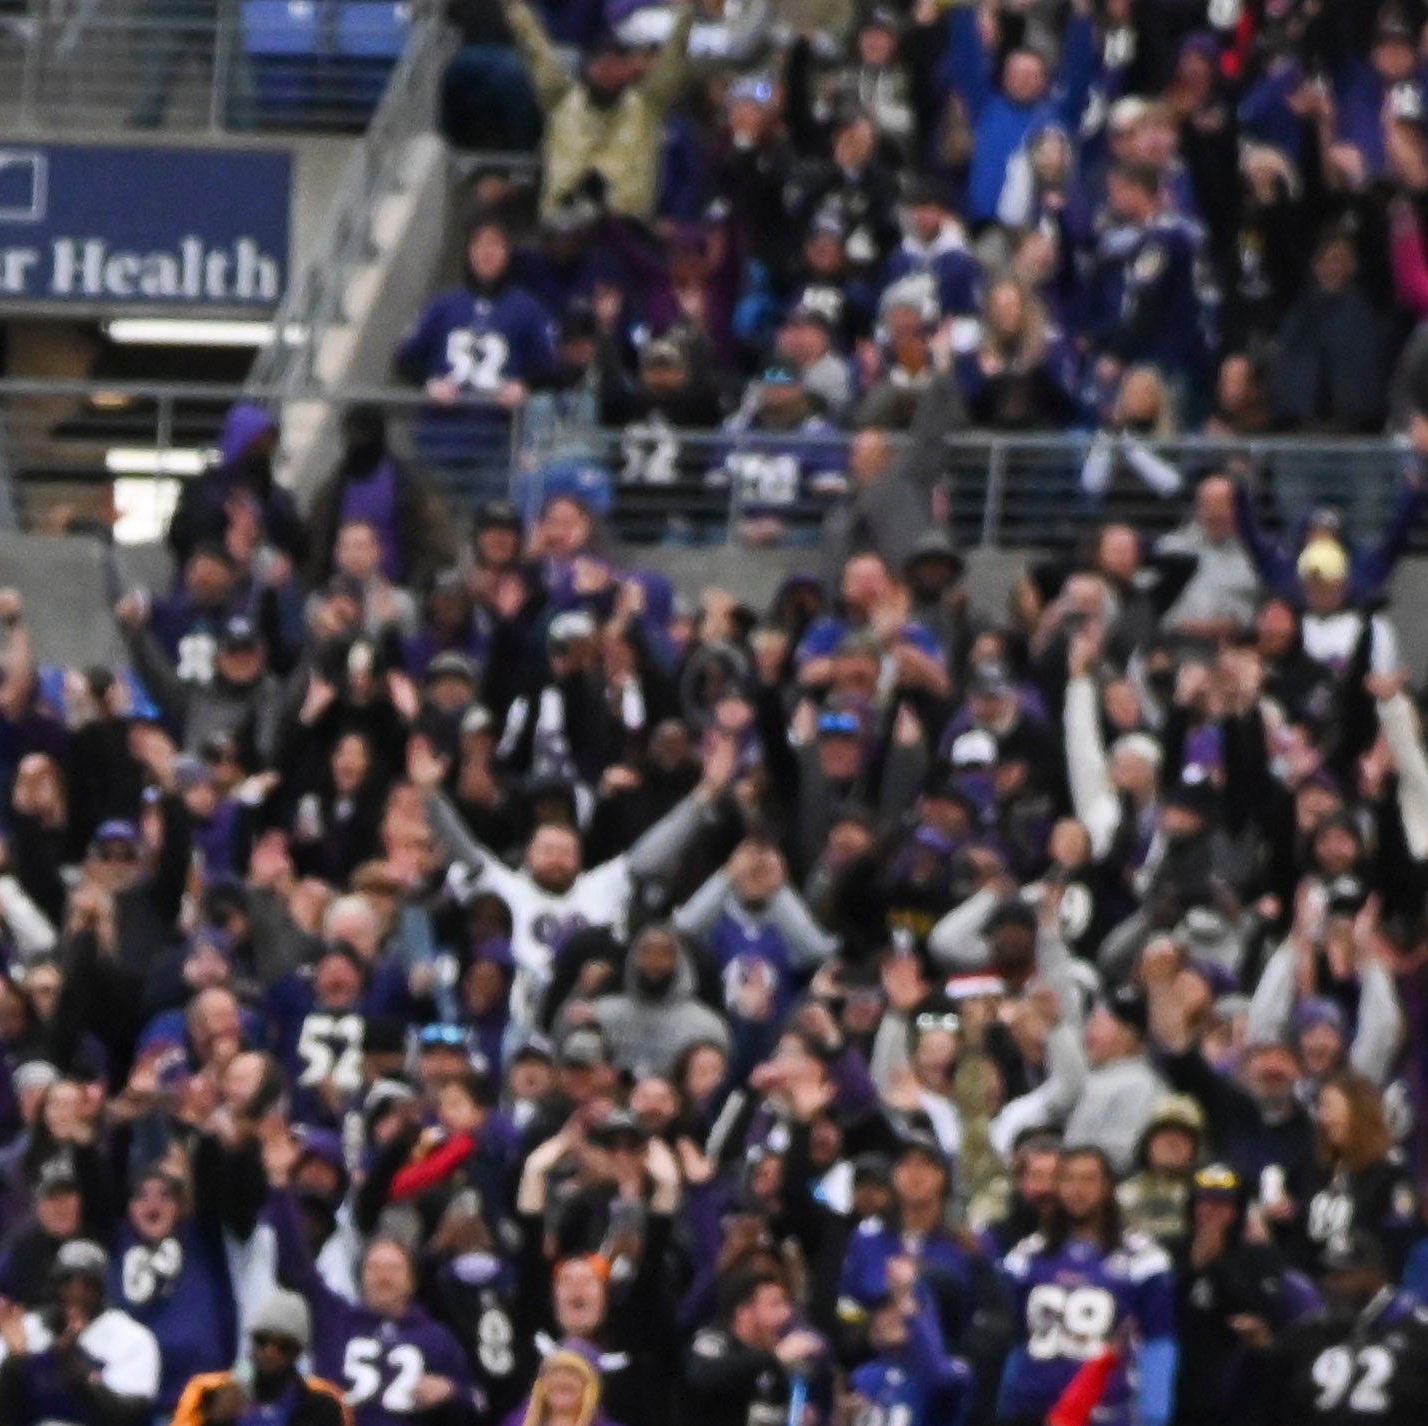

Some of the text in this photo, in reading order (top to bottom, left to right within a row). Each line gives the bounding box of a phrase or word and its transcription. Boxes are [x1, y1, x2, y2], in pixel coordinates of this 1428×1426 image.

[52, 235, 279, 300] Health
[443, 328, 511, 391] 52
[340, 1335, 427, 1413] 52
[1309, 1346, 1391, 1413] 92
